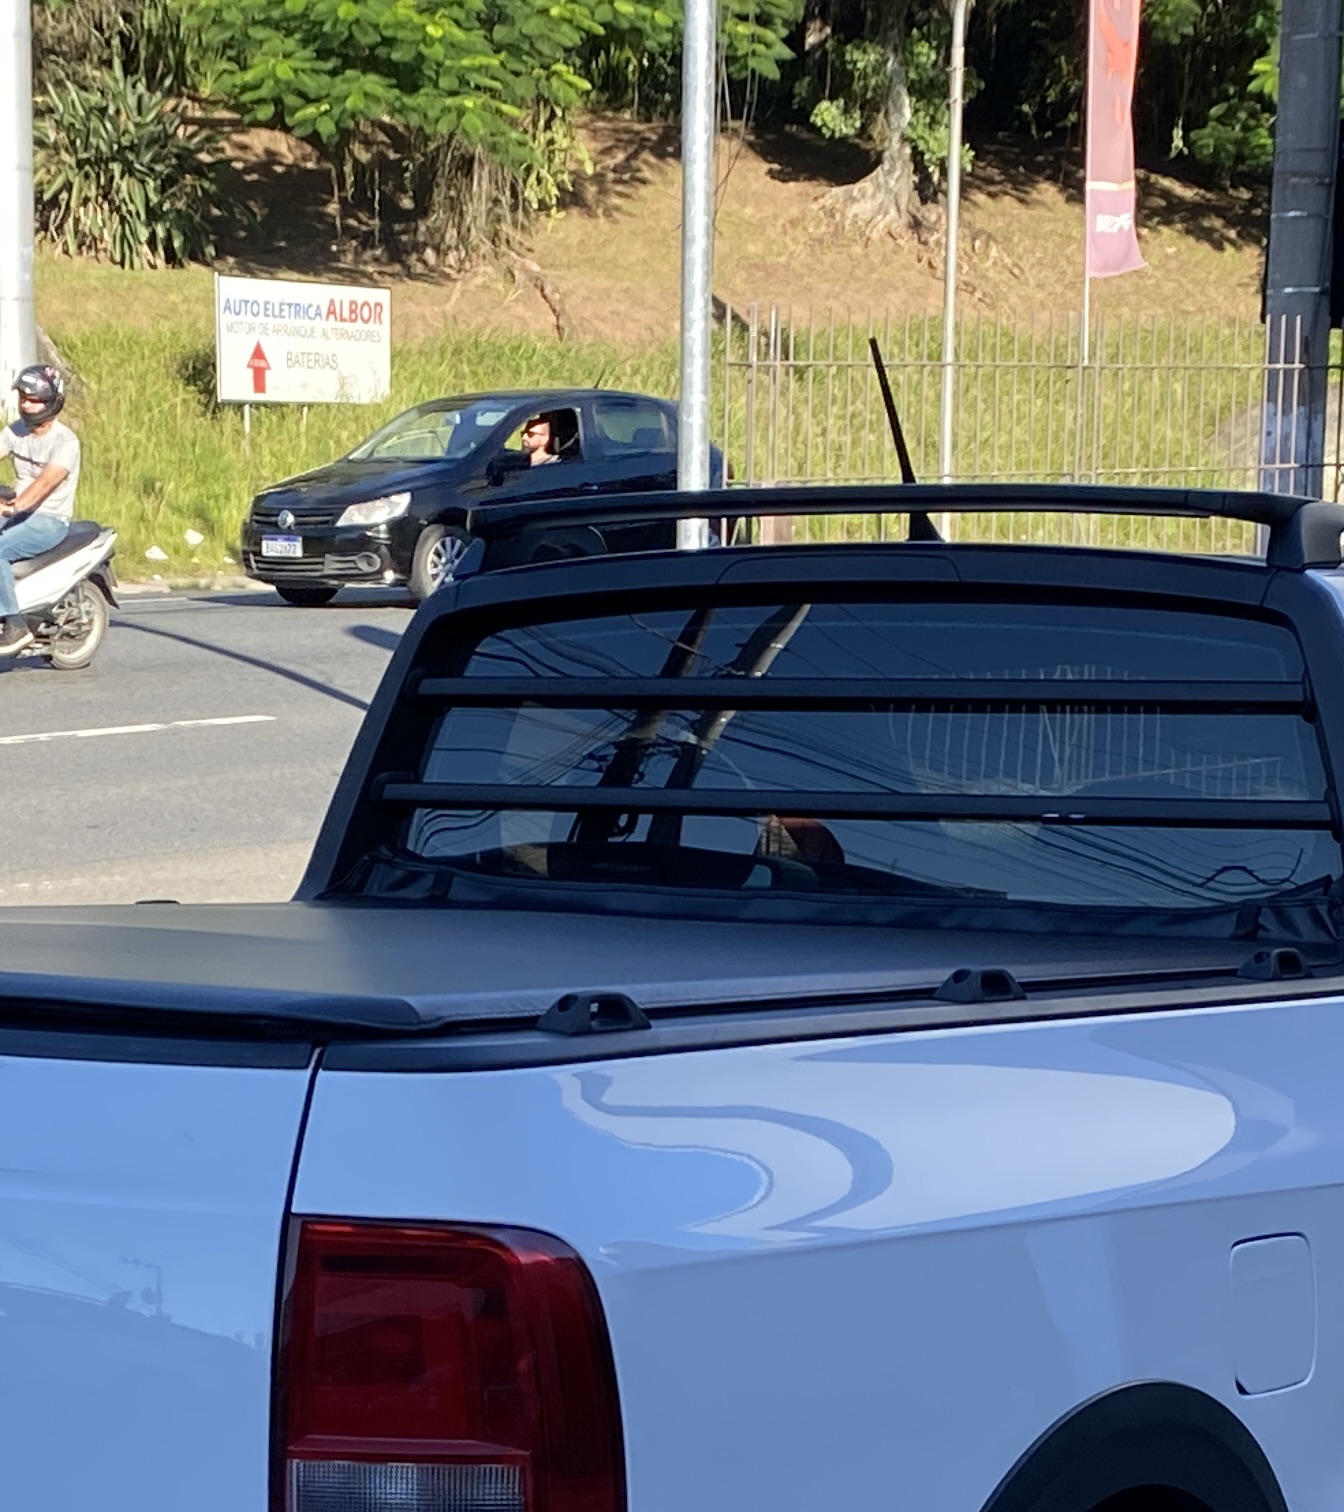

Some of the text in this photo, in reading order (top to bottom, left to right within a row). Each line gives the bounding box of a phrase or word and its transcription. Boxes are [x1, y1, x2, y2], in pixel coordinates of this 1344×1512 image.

[223, 297, 383, 325] AUTO ELÉTRICA ALBOR
[226, 320, 382, 343] MOTOR DE ARRANQUE ALTERNADORES
[286, 350, 338, 371] BATERIAS
